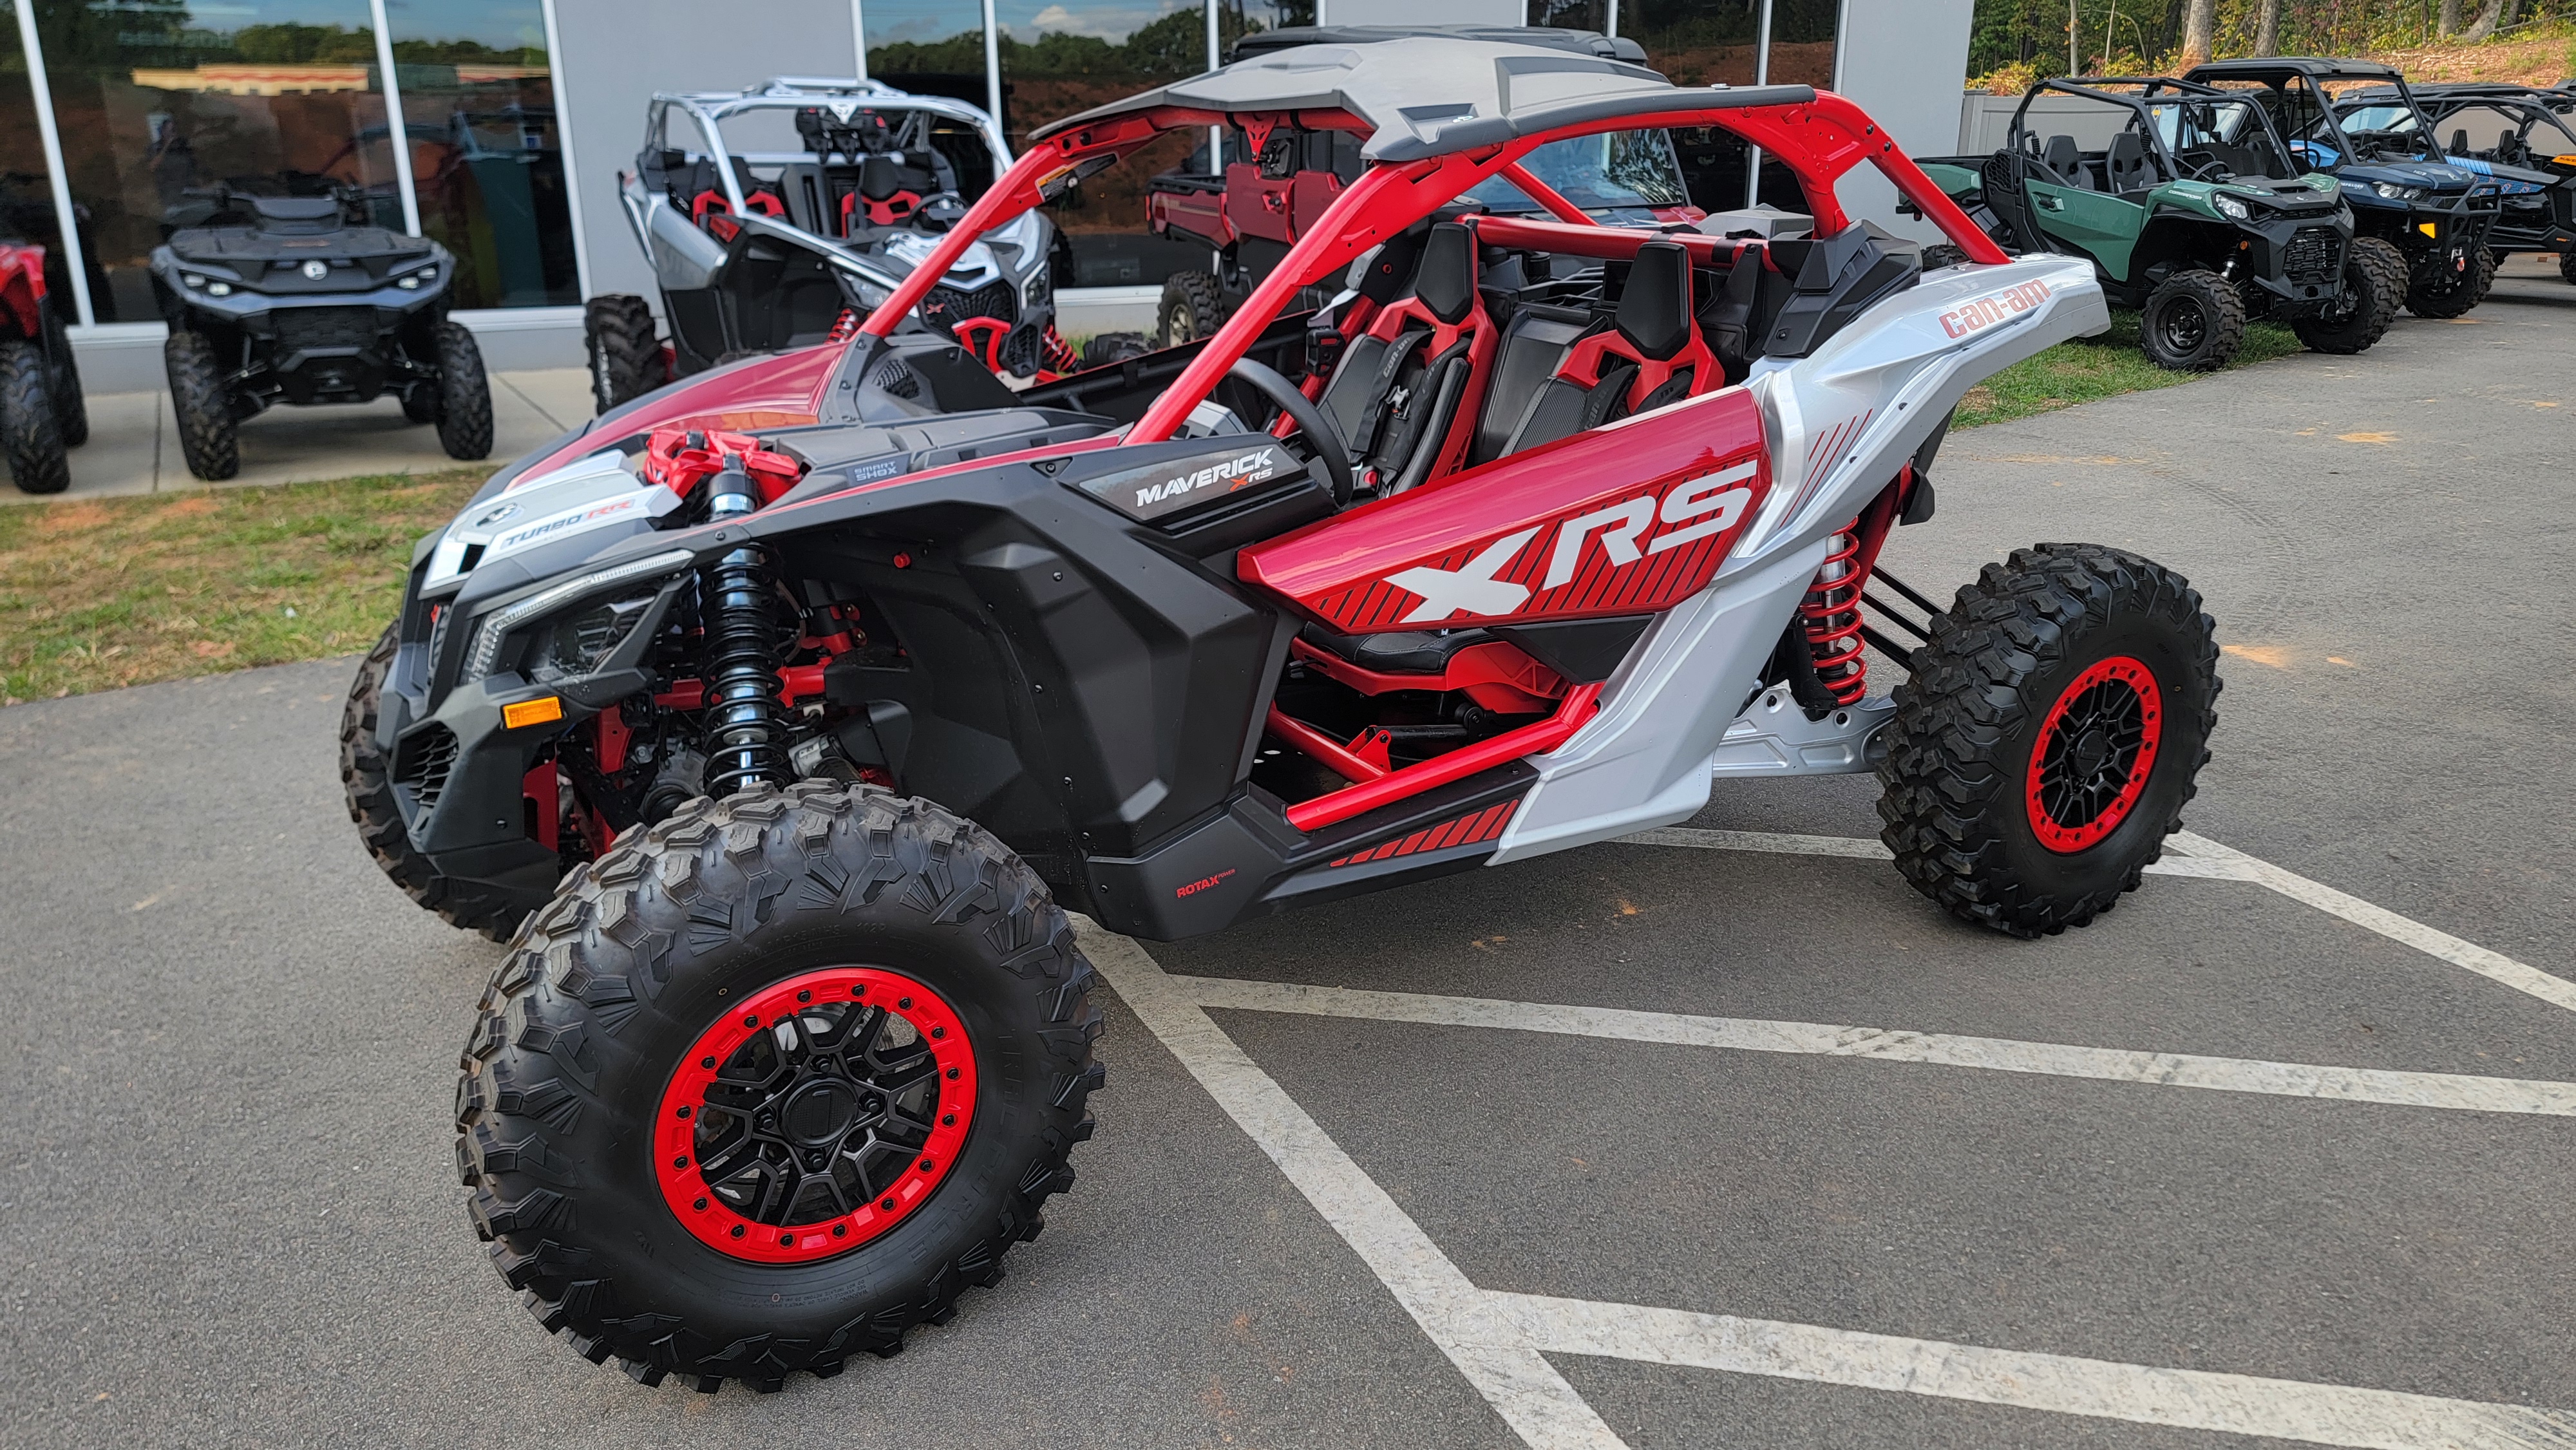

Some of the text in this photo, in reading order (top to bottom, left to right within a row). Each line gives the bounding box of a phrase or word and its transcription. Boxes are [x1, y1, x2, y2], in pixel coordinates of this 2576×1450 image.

[1938, 279, 2051, 339] can-am
[854, 460, 896, 474] SMART
[856, 466, 898, 482] SHOX
[1135, 447, 1273, 507] MAVERICK
[505, 499, 632, 546] TURBO RR
[1176, 875, 1219, 898] ROTAX
